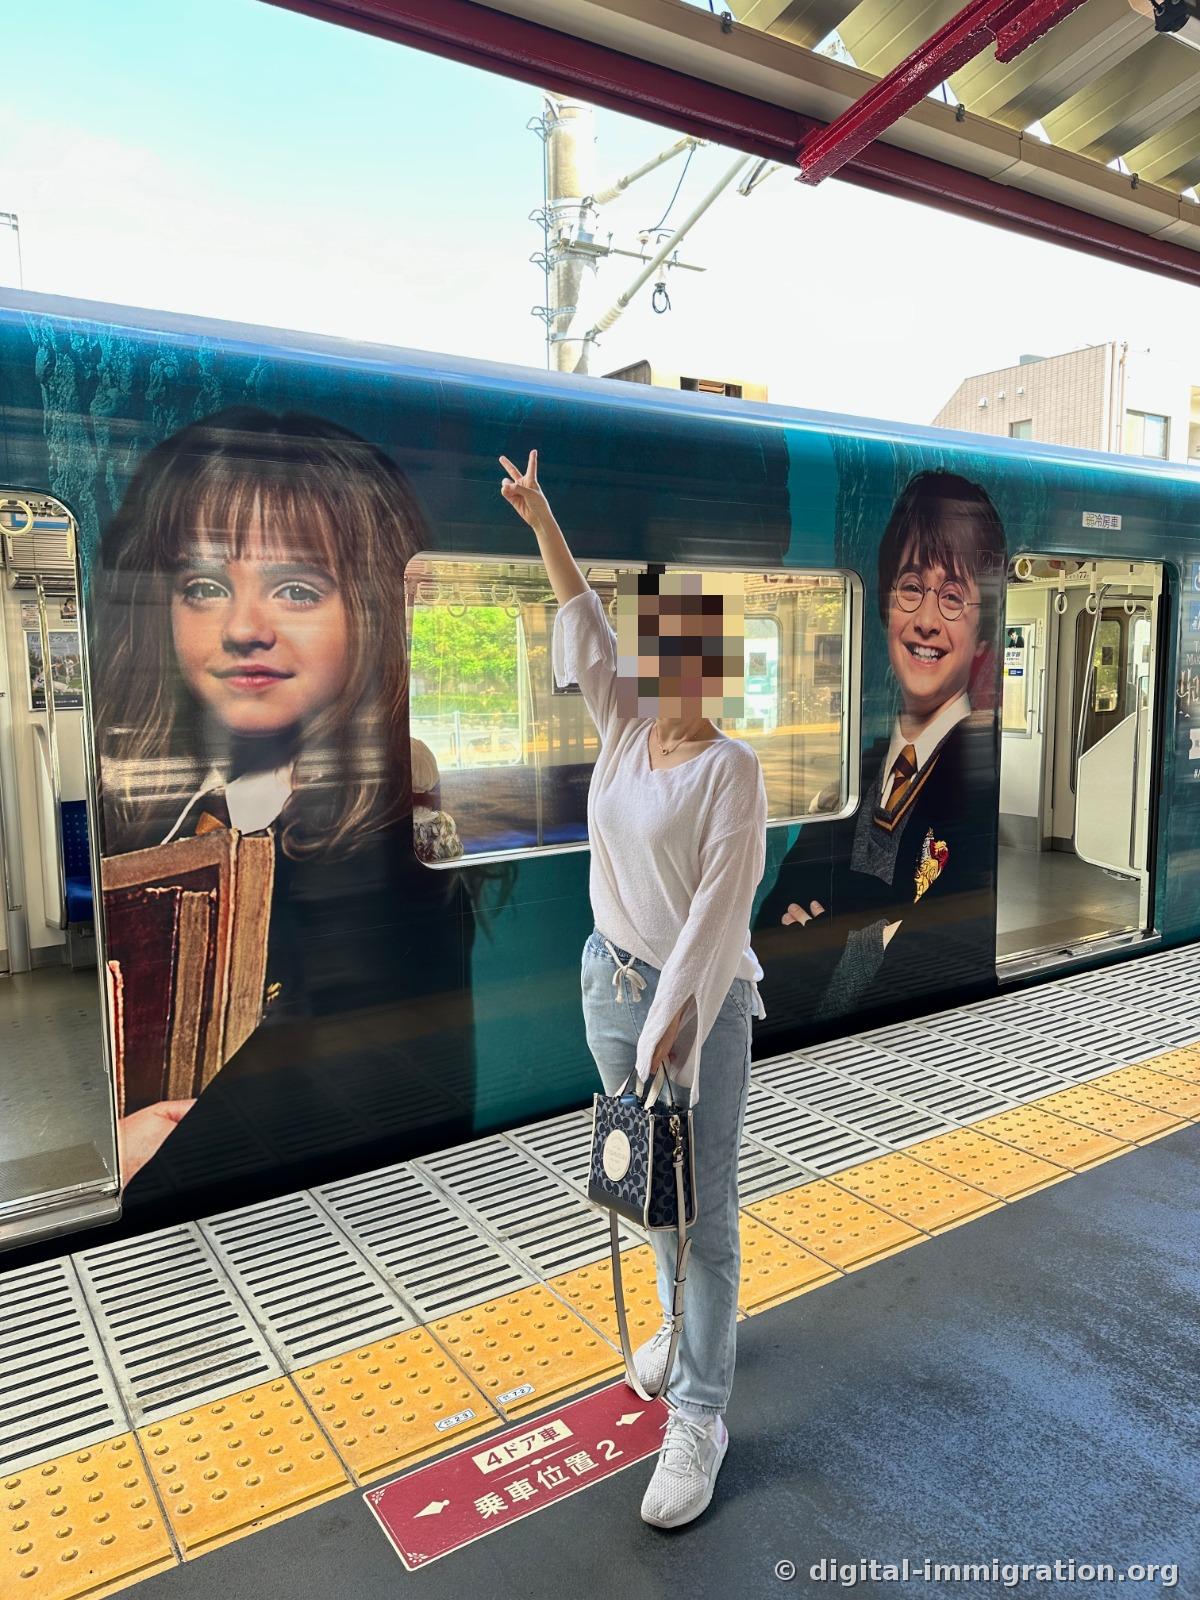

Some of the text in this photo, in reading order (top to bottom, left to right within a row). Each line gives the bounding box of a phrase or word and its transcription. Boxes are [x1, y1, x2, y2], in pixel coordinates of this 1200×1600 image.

[1086, 513, 1119, 528] 弱冷房車
[486, 1426, 561, 1467] 4ドア車
